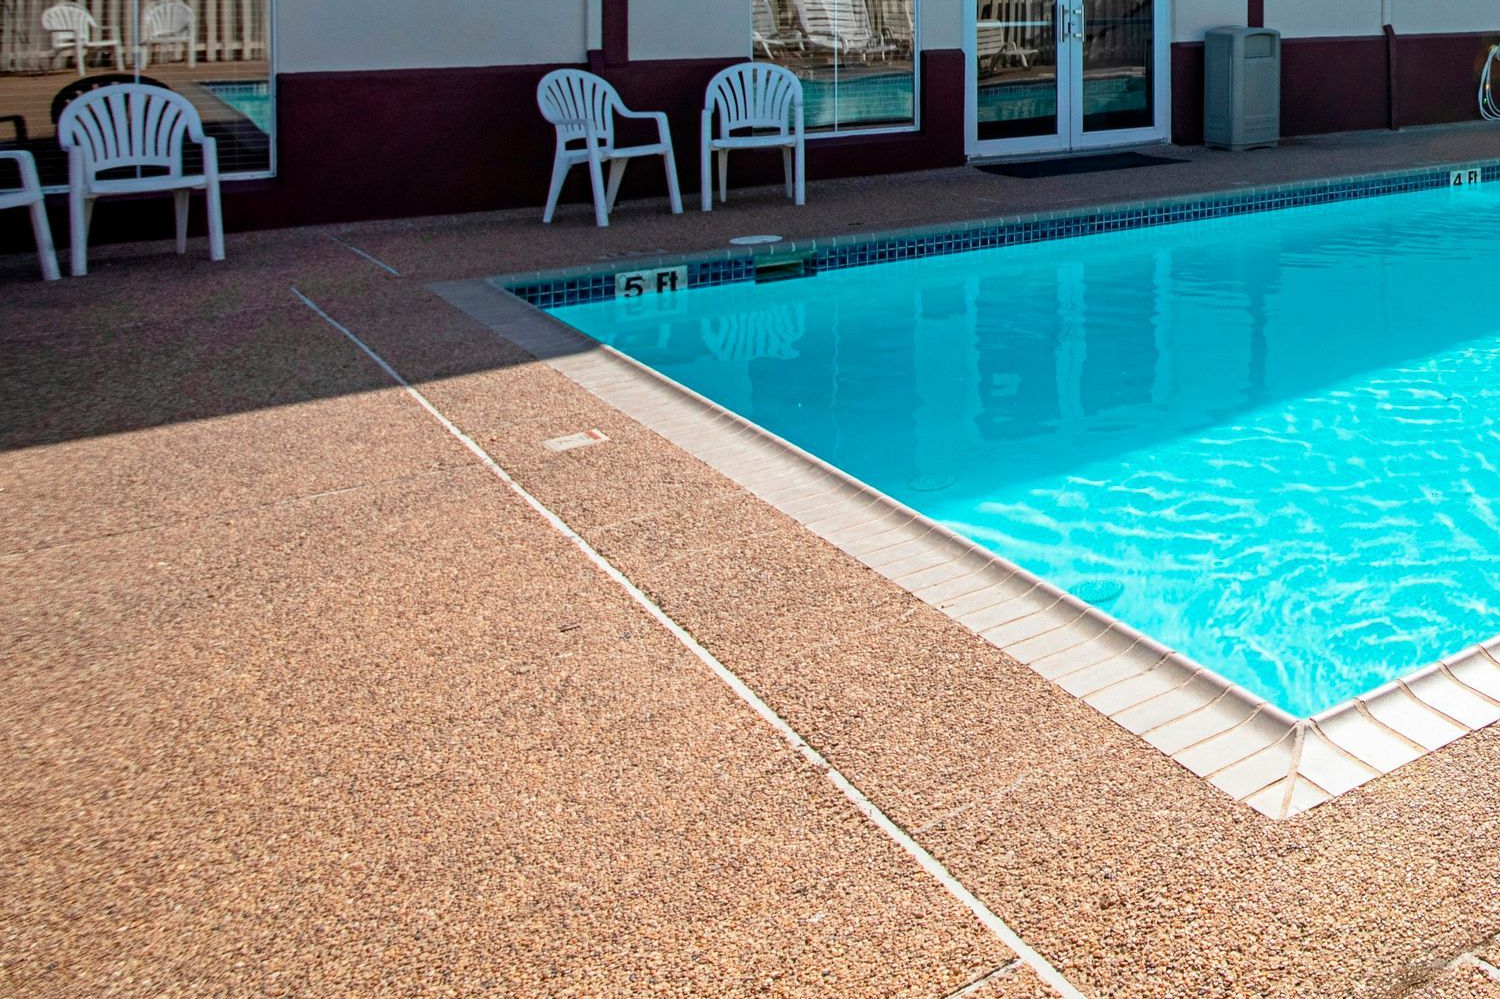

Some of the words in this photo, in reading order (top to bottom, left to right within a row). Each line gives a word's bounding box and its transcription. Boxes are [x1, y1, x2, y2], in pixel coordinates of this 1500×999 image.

[1453, 172, 1463, 186] 4
[624, 276, 645, 297] 5
[656, 270, 678, 293] Ft
